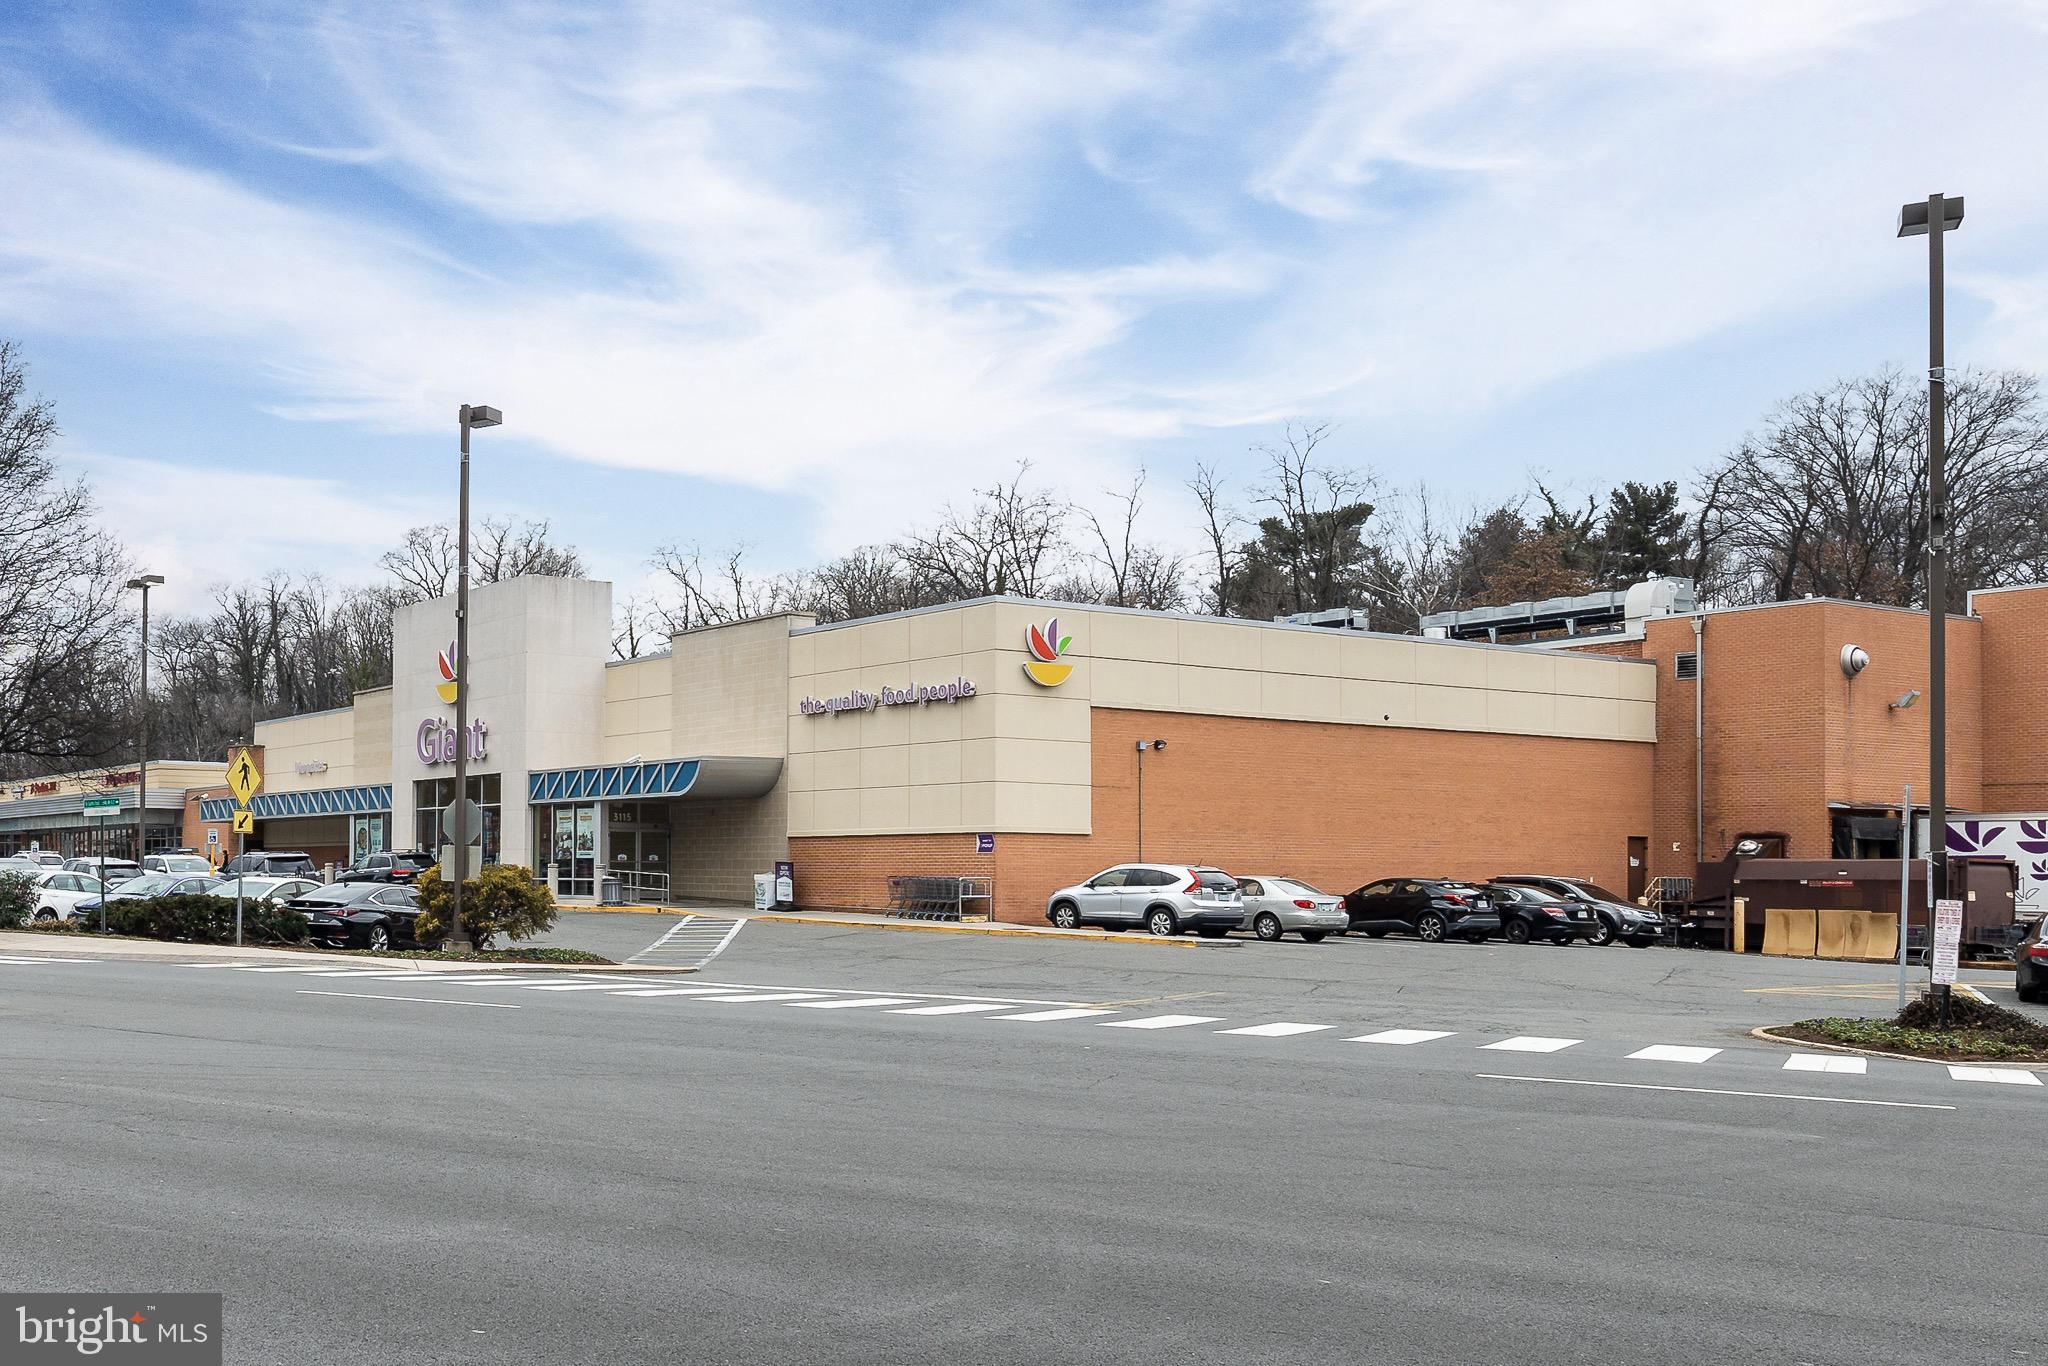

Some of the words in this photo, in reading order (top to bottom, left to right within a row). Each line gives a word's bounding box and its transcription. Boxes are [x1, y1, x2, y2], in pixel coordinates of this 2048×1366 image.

[800, 696, 823, 714] the
[825, 690, 876, 715] quality
[881, 682, 917, 705] food
[919, 676, 976, 705] people
[613, 812, 632, 822] 3115
